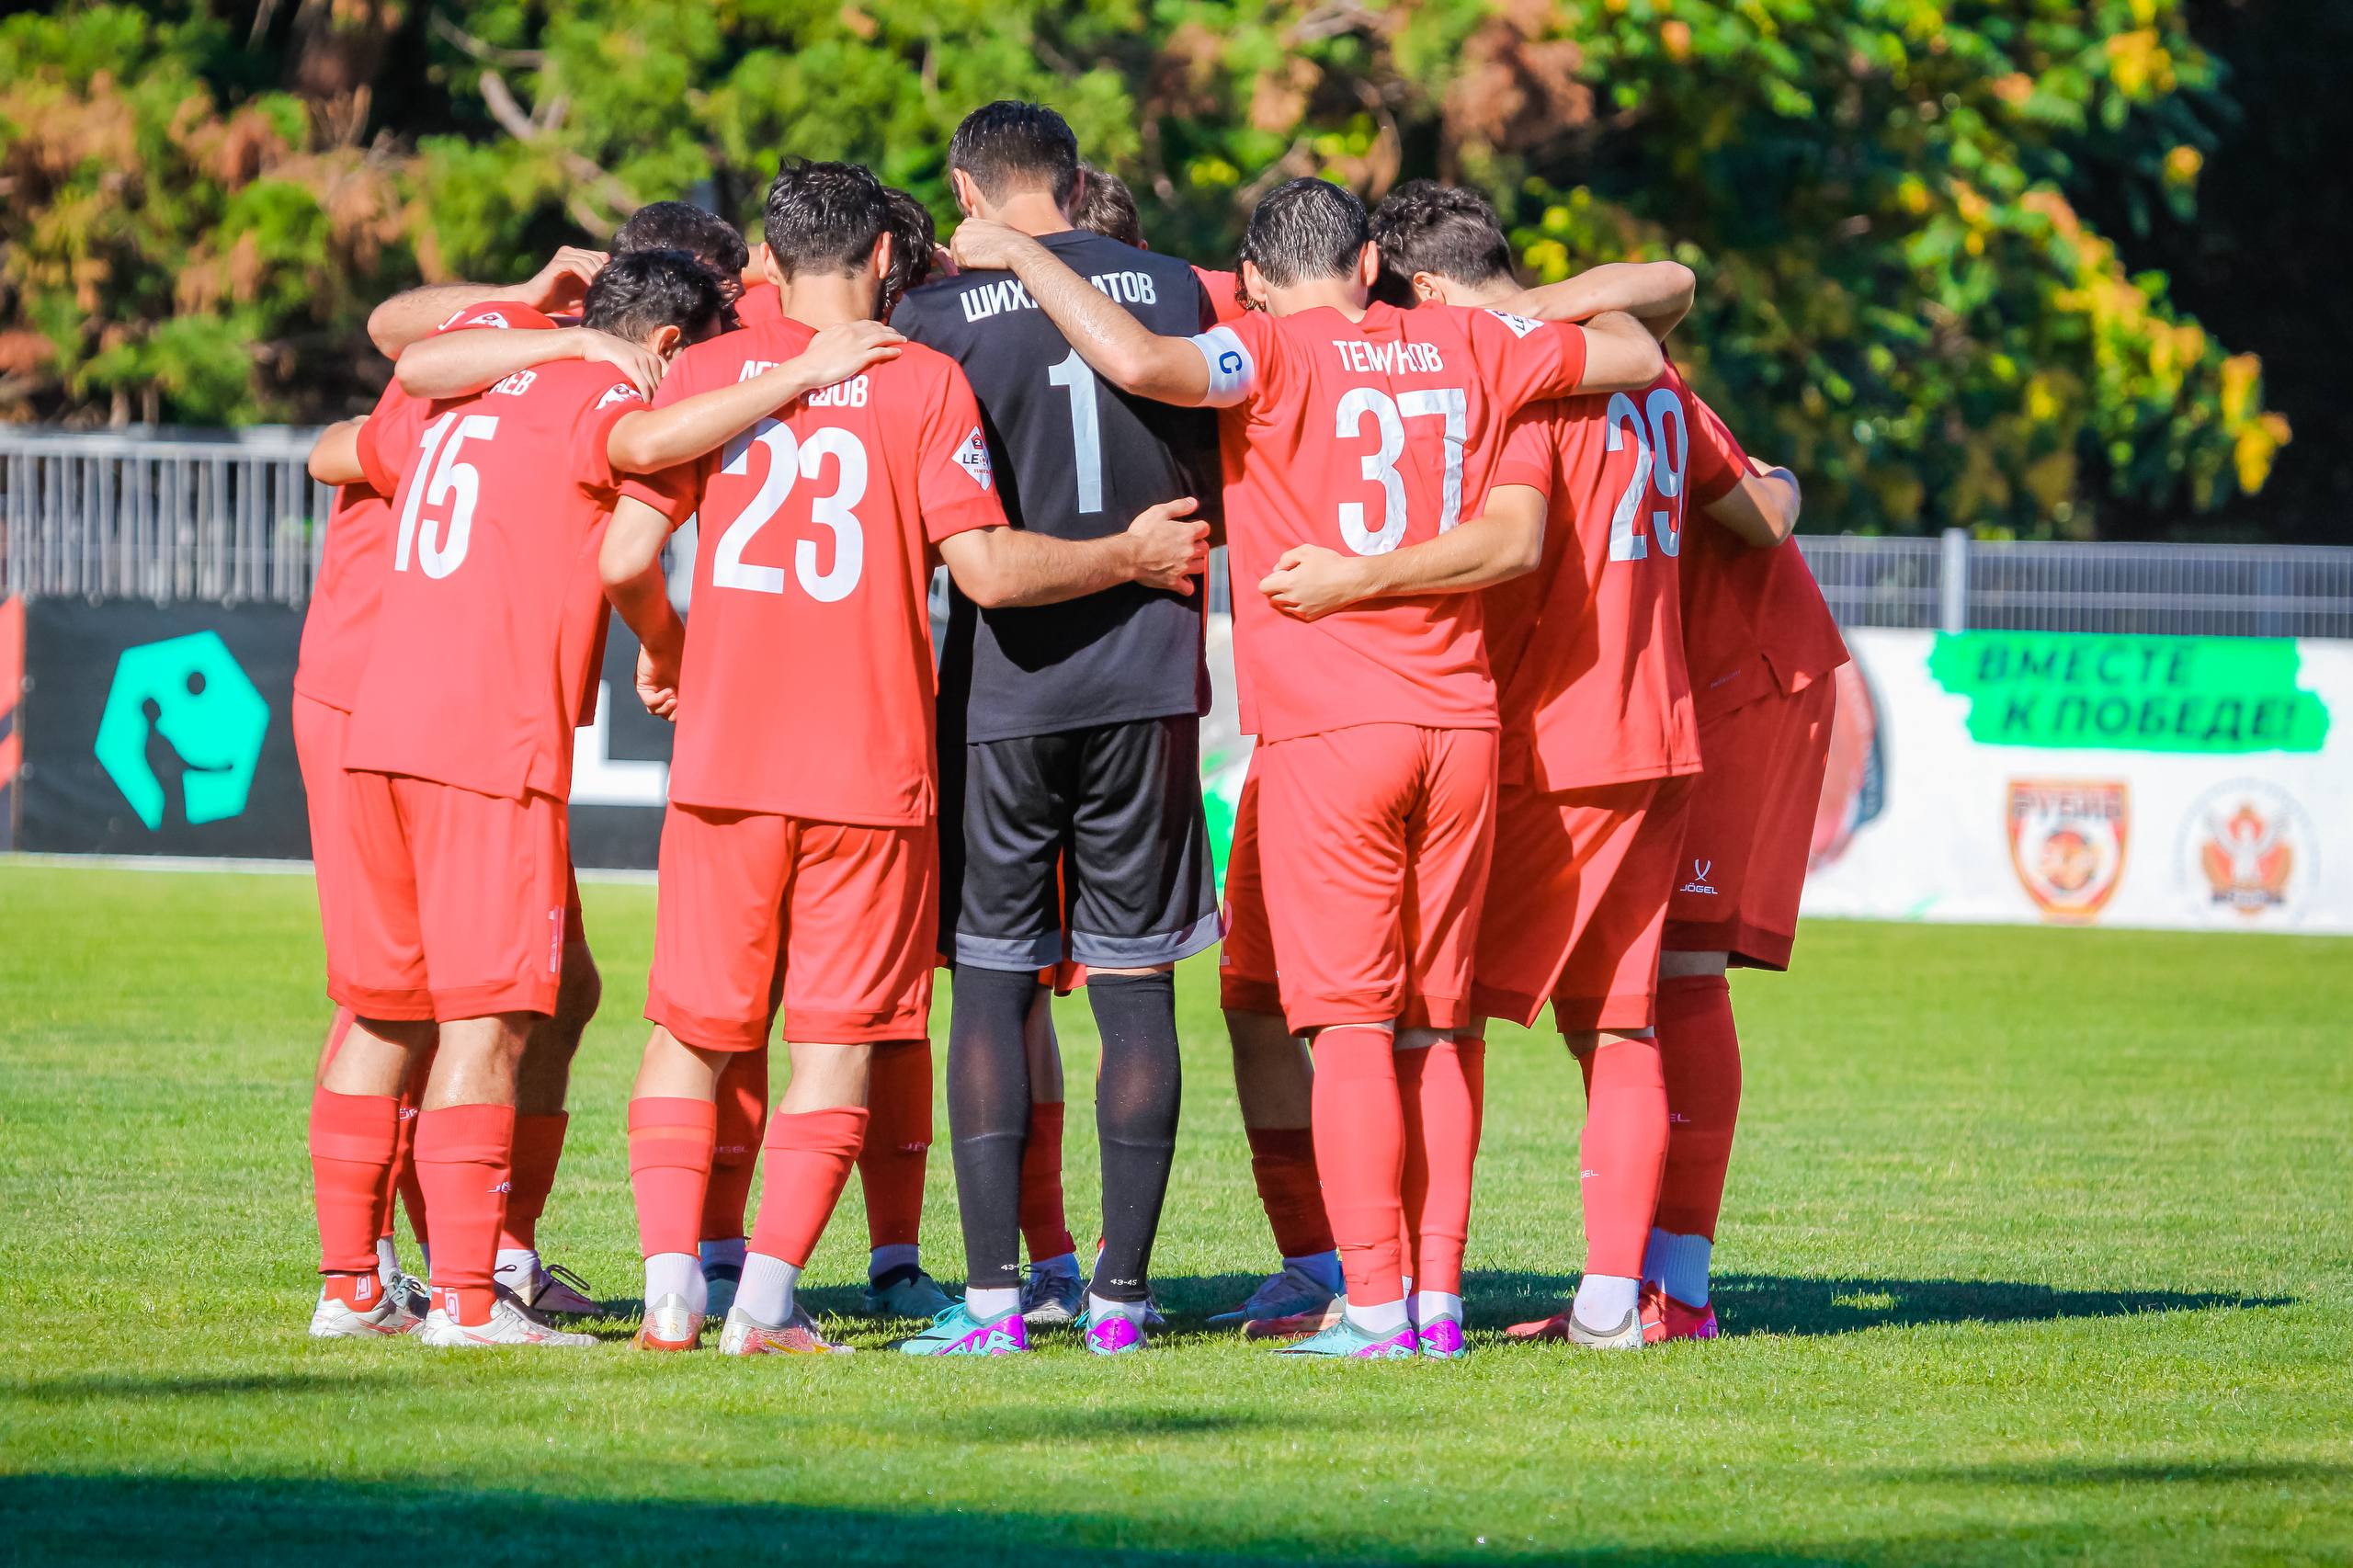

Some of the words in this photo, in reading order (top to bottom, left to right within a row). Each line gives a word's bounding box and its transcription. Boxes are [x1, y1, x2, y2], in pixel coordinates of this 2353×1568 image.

[960, 271, 1156, 323] ШИХАТОВ
[1219, 350, 1243, 374] C
[1048, 347, 1103, 514] 1
[393, 411, 500, 580] 15
[1335, 387, 1468, 557] 37
[1606, 388, 1689, 562] 29
[712, 416, 868, 603] 23
[1976, 644, 2196, 686] ВМЕСТЕ
[2002, 696, 2040, 733] К
[2052, 695, 2298, 743] ПОБЕДЕ!
[1679, 882, 1719, 894] JÖGEL
[1109, 1278, 1138, 1286] 43-45
